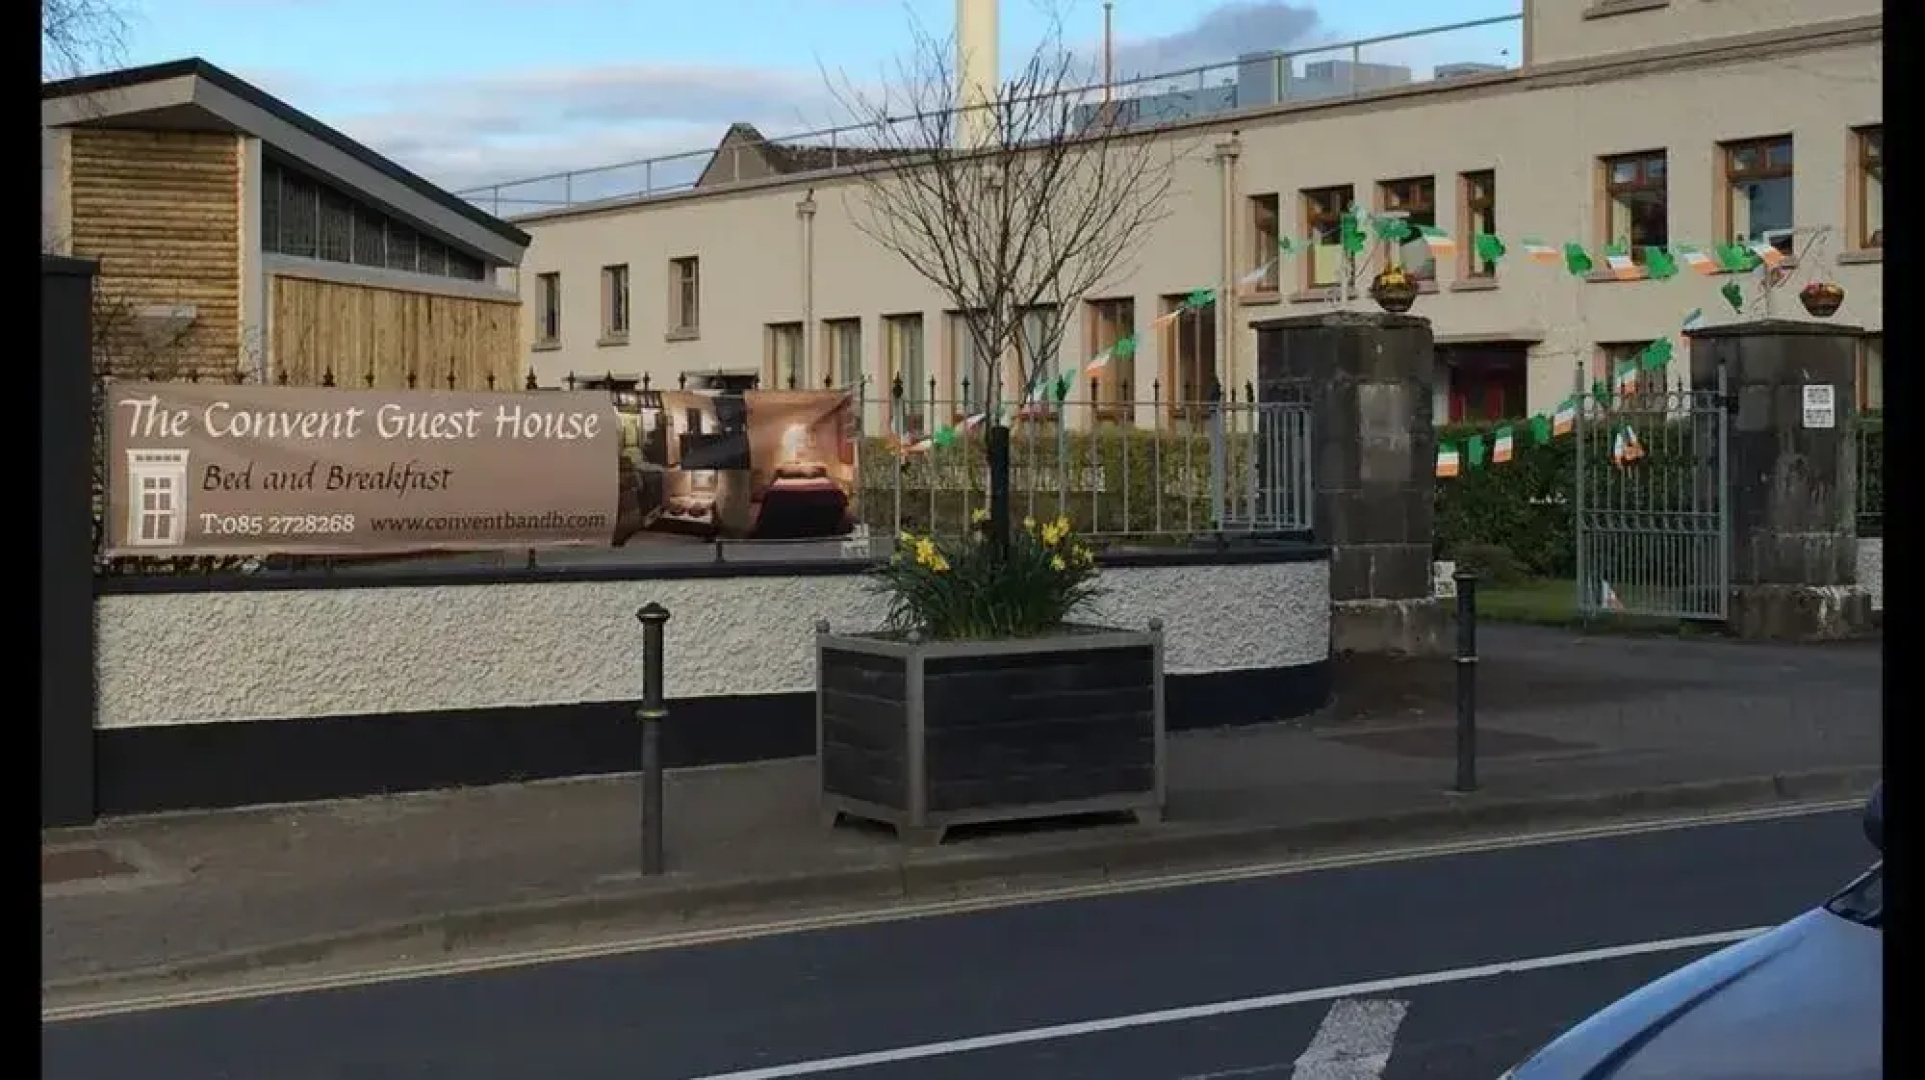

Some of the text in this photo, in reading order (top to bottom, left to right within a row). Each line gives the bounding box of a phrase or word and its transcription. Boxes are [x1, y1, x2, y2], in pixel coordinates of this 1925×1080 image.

[119, 395, 600, 440] The Convent Guest House
[202, 459, 454, 498] Bed and Breakfast
[200, 511, 606, 535] T:085 2728268 www.conventbandb.com
